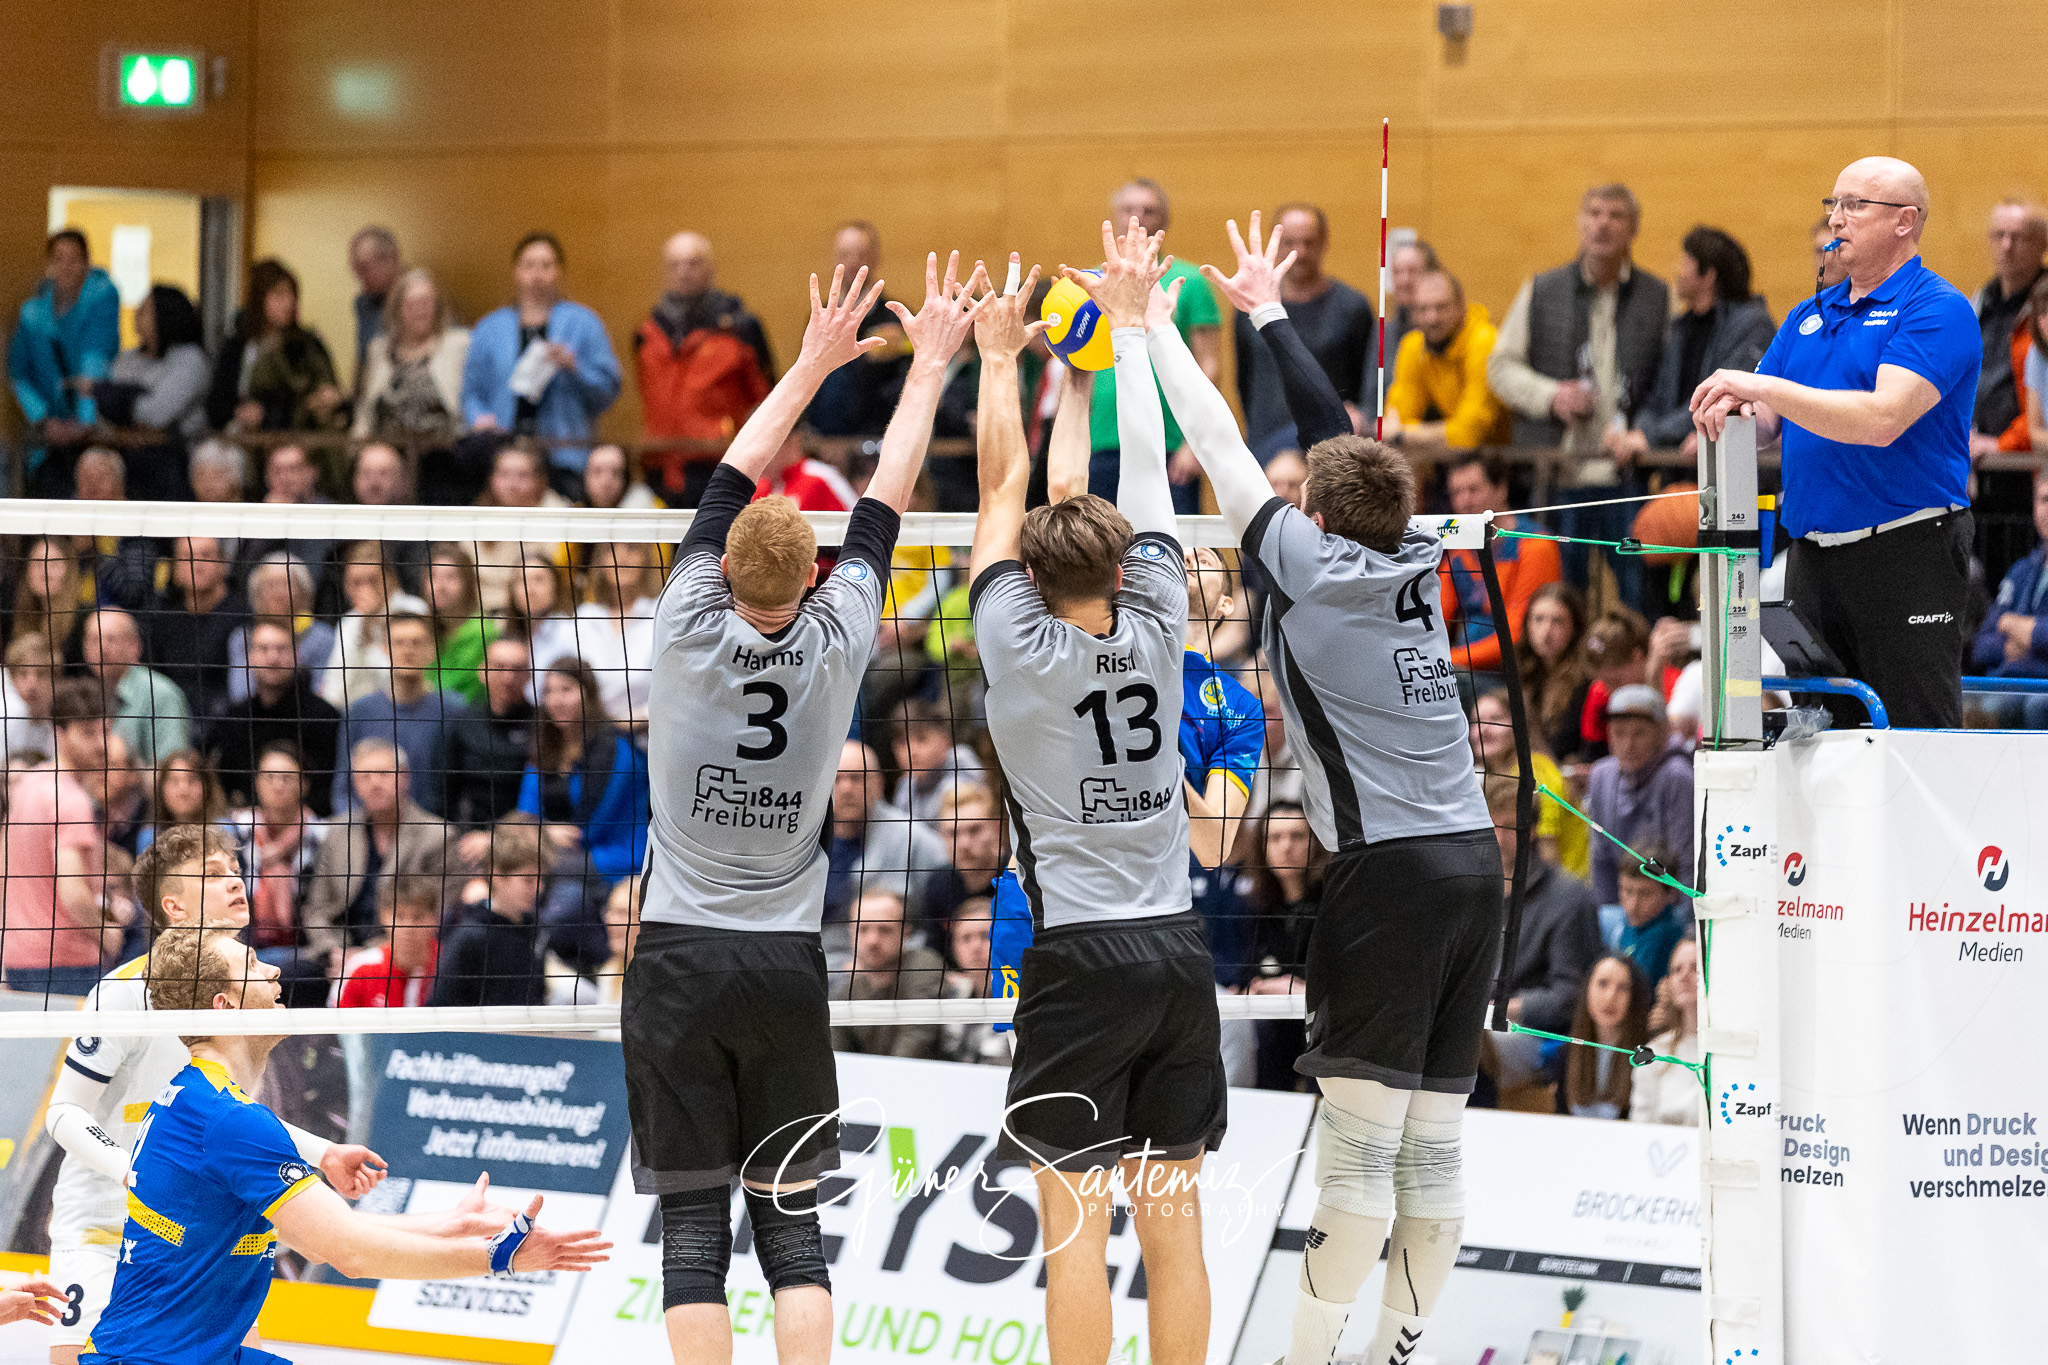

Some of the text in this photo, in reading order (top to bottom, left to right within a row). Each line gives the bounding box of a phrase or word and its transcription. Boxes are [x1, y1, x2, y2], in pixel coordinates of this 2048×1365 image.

[1075, 310, 1091, 338] V200W
[1395, 568, 1434, 632] 4
[1908, 613, 1945, 625] CRAFT
[732, 645, 804, 670] Harms
[1096, 648, 1137, 674] Ristl
[736, 681, 789, 761] 3
[1073, 683, 1162, 766] 13
[750, 787, 803, 810] 1844
[691, 797, 801, 834] Freiburg
[1730, 844, 1767, 859] Zapf
[1908, 902, 2048, 932] Heinzelma
[1958, 941, 2023, 961] Medien
[1735, 1103, 1771, 1117] Zapf
[1902, 1112, 2037, 1135] Wenn Druck
[422, 1126, 607, 1170] Jetzt informieren!
[1783, 1138, 1850, 1167] Design
[1943, 1143, 1983, 1166] und
[1910, 1175, 2048, 1198] verschmelze
[416, 1284, 533, 1316] SERVICES
[841, 1302, 943, 1355] UND
